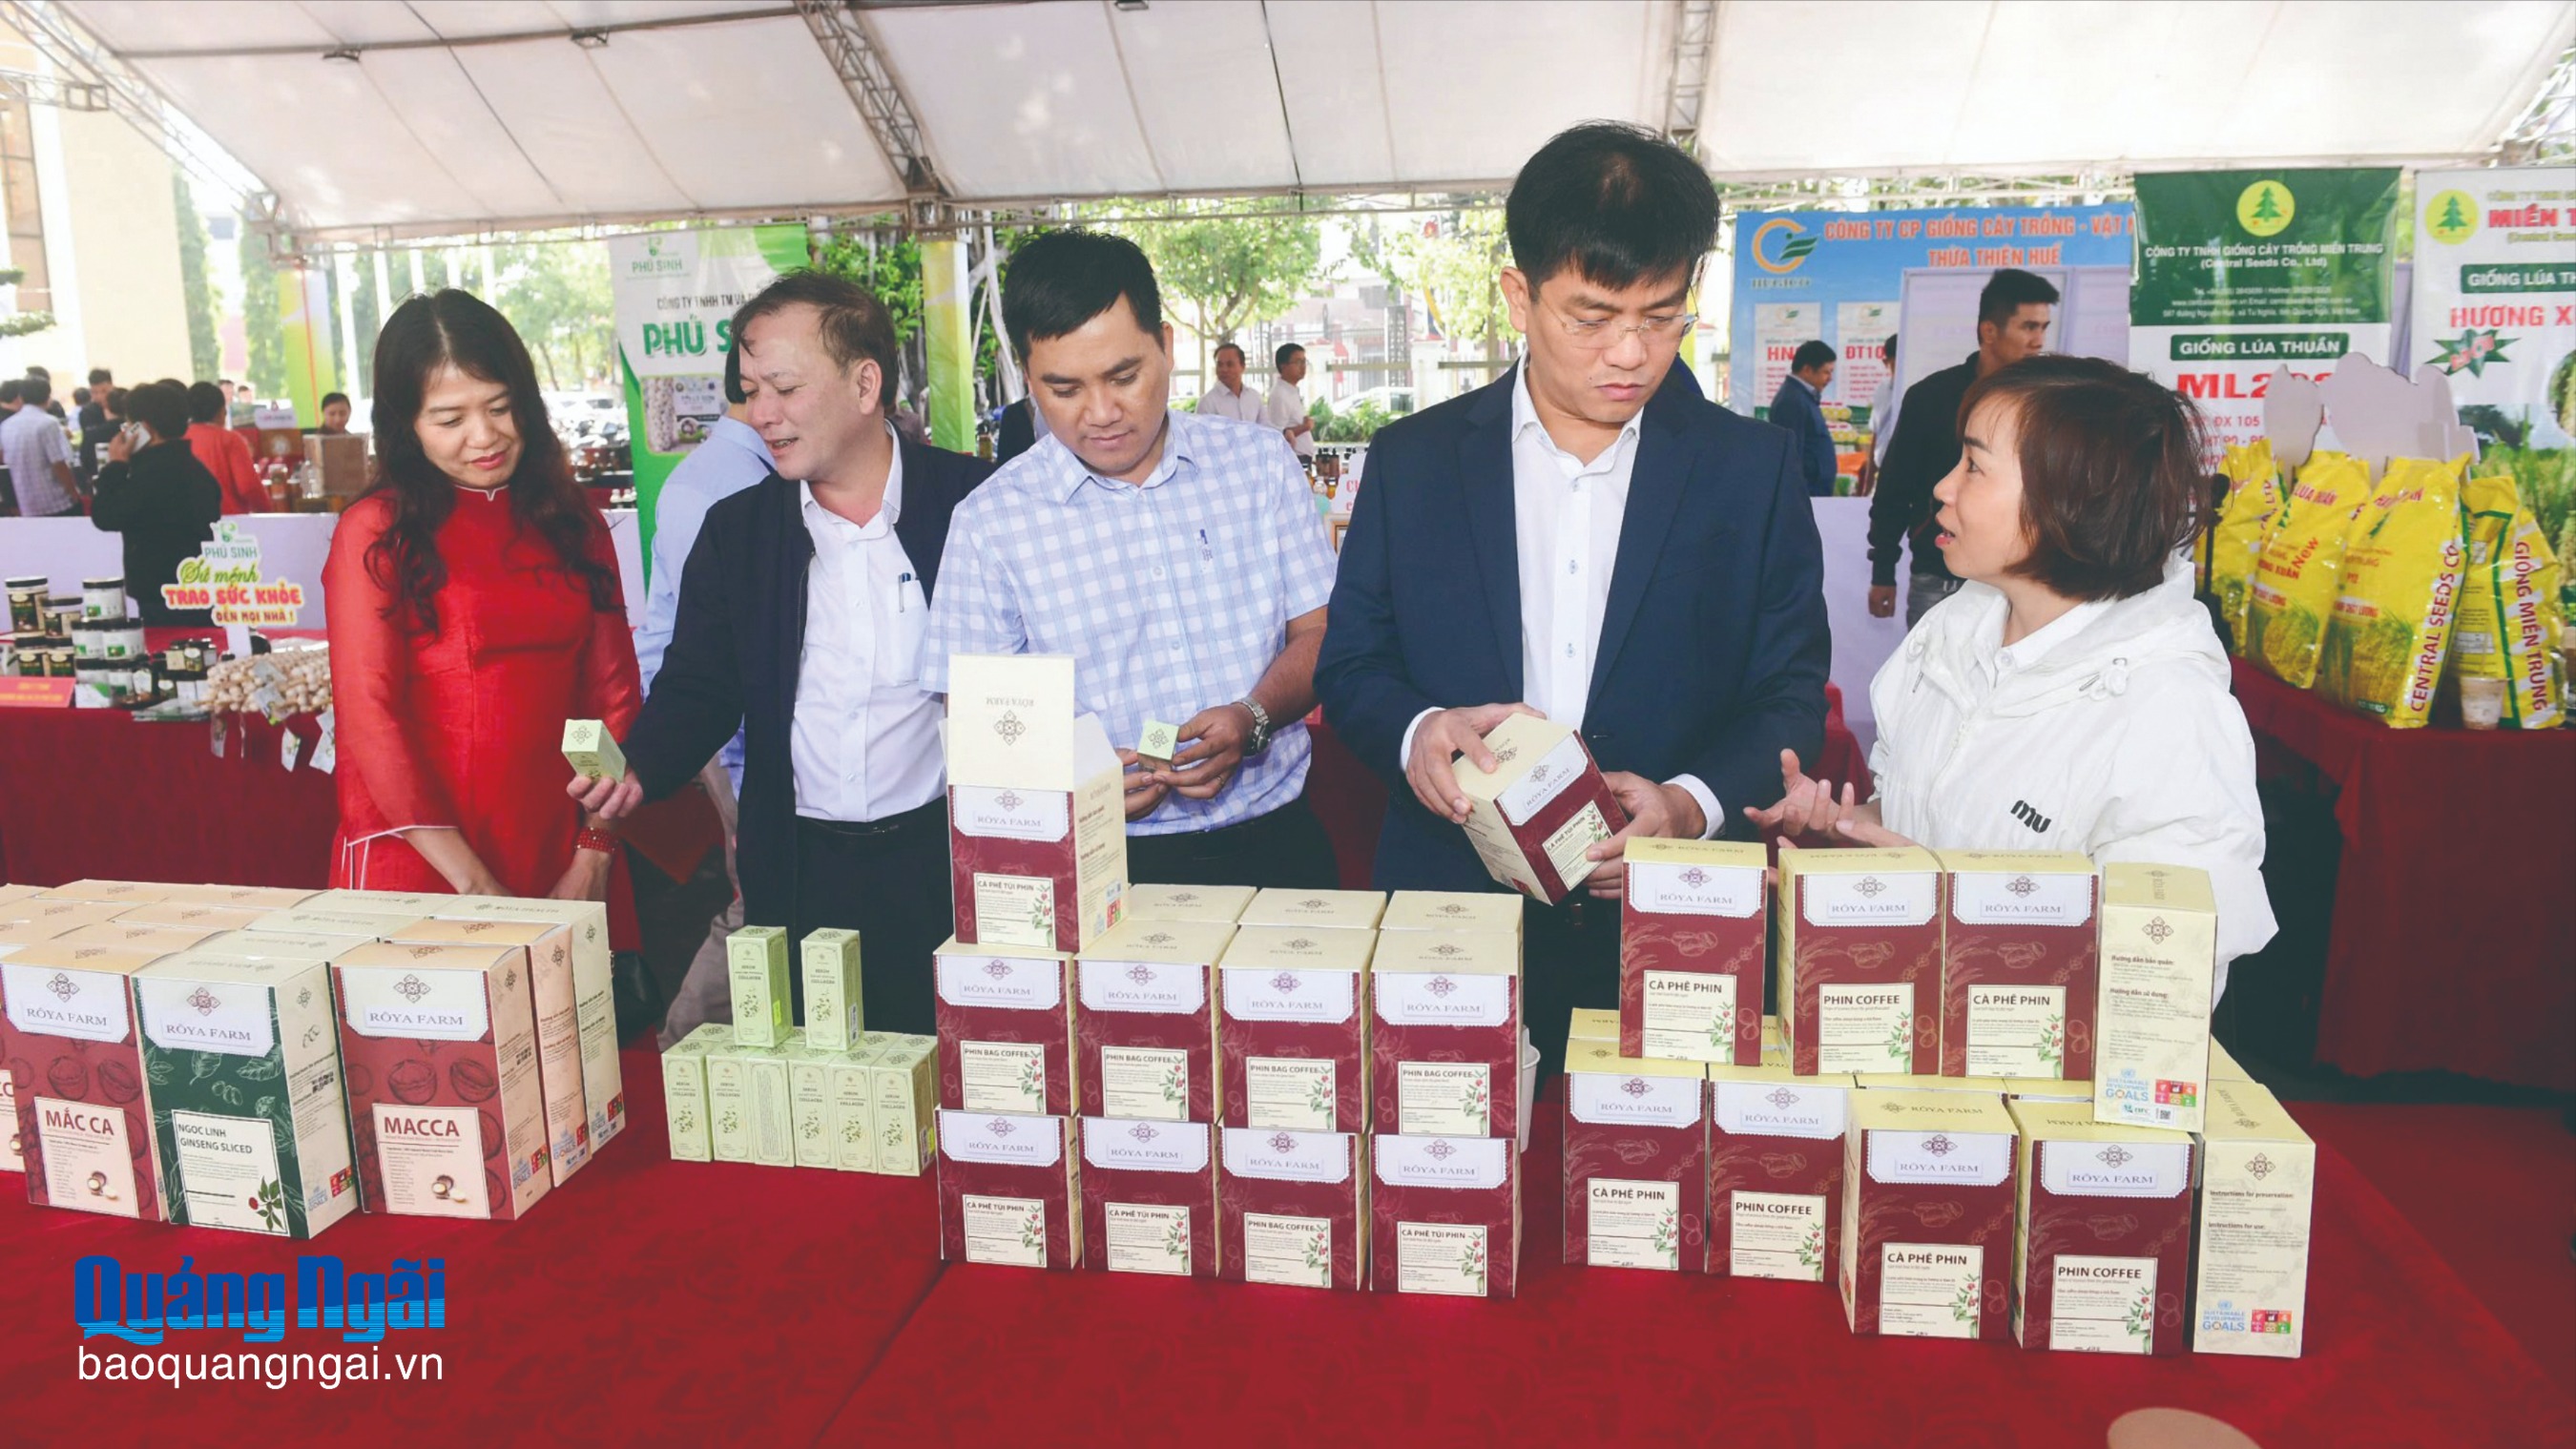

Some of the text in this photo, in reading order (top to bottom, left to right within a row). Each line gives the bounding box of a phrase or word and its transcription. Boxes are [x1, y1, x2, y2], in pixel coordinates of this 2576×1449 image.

[2488, 203, 2558, 228] MIỀN
[1824, 217, 1870, 240] CÔNG
[1875, 219, 1895, 238] TY
[1899, 219, 1921, 238] CP
[1926, 211, 1978, 238] GIỐNG
[1982, 214, 2014, 238] CÂY
[2021, 210, 2074, 236] TRỒNG
[2090, 211, 2123, 239] VẬT
[1927, 240, 2064, 266] THỪA THIÊN HUẾ
[2146, 245, 2175, 258] CÔNG
[2177, 245, 2192, 257] TY
[2193, 246, 2221, 257] TNHH
[2224, 242, 2256, 256] GIỐNG
[2258, 242, 2280, 256] CÂY
[2282, 241, 2317, 256] TRỒNG
[2347, 242, 2383, 255] TRUNG
[656, 259, 683, 273] SINH
[2200, 258, 2243, 270] (Central
[2245, 258, 2278, 268] Seeds
[2305, 256, 2328, 269] Ltd)
[2467, 268, 2556, 287] GIỐNG LÚA
[656, 295, 680, 310] CÔNG
[681, 298, 692, 308] TY
[720, 294, 734, 306] TM
[2449, 304, 2545, 328] HƯƠNG
[2179, 335, 2340, 354] GIỐNG LÚA THUẦN
[2236, 416, 2260, 427] 105
[230, 547, 258, 559] SINH
[2292, 536, 2319, 569] New
[164, 581, 302, 606] TRAO SỨC KHỎE
[241, 611, 260, 625] MỌI
[263, 608, 287, 622] NHÀ
[2514, 540, 2548, 712] GIỐNG MIỀN TRUNG
[2410, 631, 2441, 713] CENTRAL
[2429, 572, 2455, 628] SEEDS
[1527, 767, 1571, 807] RÔYA FARM
[976, 814, 1042, 828] RÔYA FARM
[1660, 892, 1733, 905] RÔYA FARM
[1832, 902, 1906, 913] RÔYA FARM
[1985, 902, 2062, 914] RÔYA FARM
[964, 983, 1031, 996] RÔYA FARM
[1649, 978, 1722, 994] CÀ PHÊ PHIN
[1107, 989, 1177, 1002] RÔYA FARM
[1823, 994, 1901, 1005] PHIN COFFEE
[1973, 993, 2050, 1006] CÀ PHÊ PHIN
[1252, 998, 1323, 1010] RÔYA FARM
[1406, 1002, 1481, 1013] RÔYA FARM
[27, 1006, 108, 1026] RÔYA FARM
[369, 1011, 464, 1025] RÔYA FARM
[166, 1024, 251, 1041] RÔYA FARM
[964, 1047, 1030, 1058] PHIN BAG COFFEE
[1106, 1053, 1125, 1062] PHIN
[1144, 1055, 1173, 1064] COFFEE
[1251, 1064, 1270, 1072] PHIN
[1290, 1066, 1319, 1074] COFFEE
[1402, 1068, 1472, 1079] PHIN BAG COFFEE
[2106, 1087, 2150, 1102] GOALS
[1600, 1101, 1672, 1113] RÔYA FARM
[45, 1107, 115, 1136] MẮC CA
[1745, 1112, 1819, 1126] RÔYA FARM
[205, 1127, 227, 1137] LINH
[384, 1116, 461, 1137] MACCA
[179, 1137, 254, 1155] GINSENG SLICED
[968, 1140, 1034, 1152] RÔYA FARM
[1111, 1148, 1179, 1159] RÔYA FARM
[1250, 1157, 1319, 1170] RÔYA FARM
[1403, 1163, 1476, 1176] RÔYA FARM
[1900, 1161, 1979, 1173] RÔYA FARM
[2071, 1171, 2153, 1185] RÔYA FARM
[1592, 1185, 1666, 1200] CÀ PHÊ PHIN
[1735, 1201, 1813, 1215] PHIN COFFEE
[1248, 1219, 1314, 1232] PHIN BAG COFFEE
[1402, 1228, 1413, 1237] CÀ
[1415, 1228, 1429, 1238] PHÊ
[1445, 1230, 1465, 1239] PHIN
[1887, 1251, 1968, 1266] CÀ PHÊ PHIN
[2057, 1266, 2143, 1280] PHIN COFFEE
[2202, 1320, 2245, 1332] GOALS
